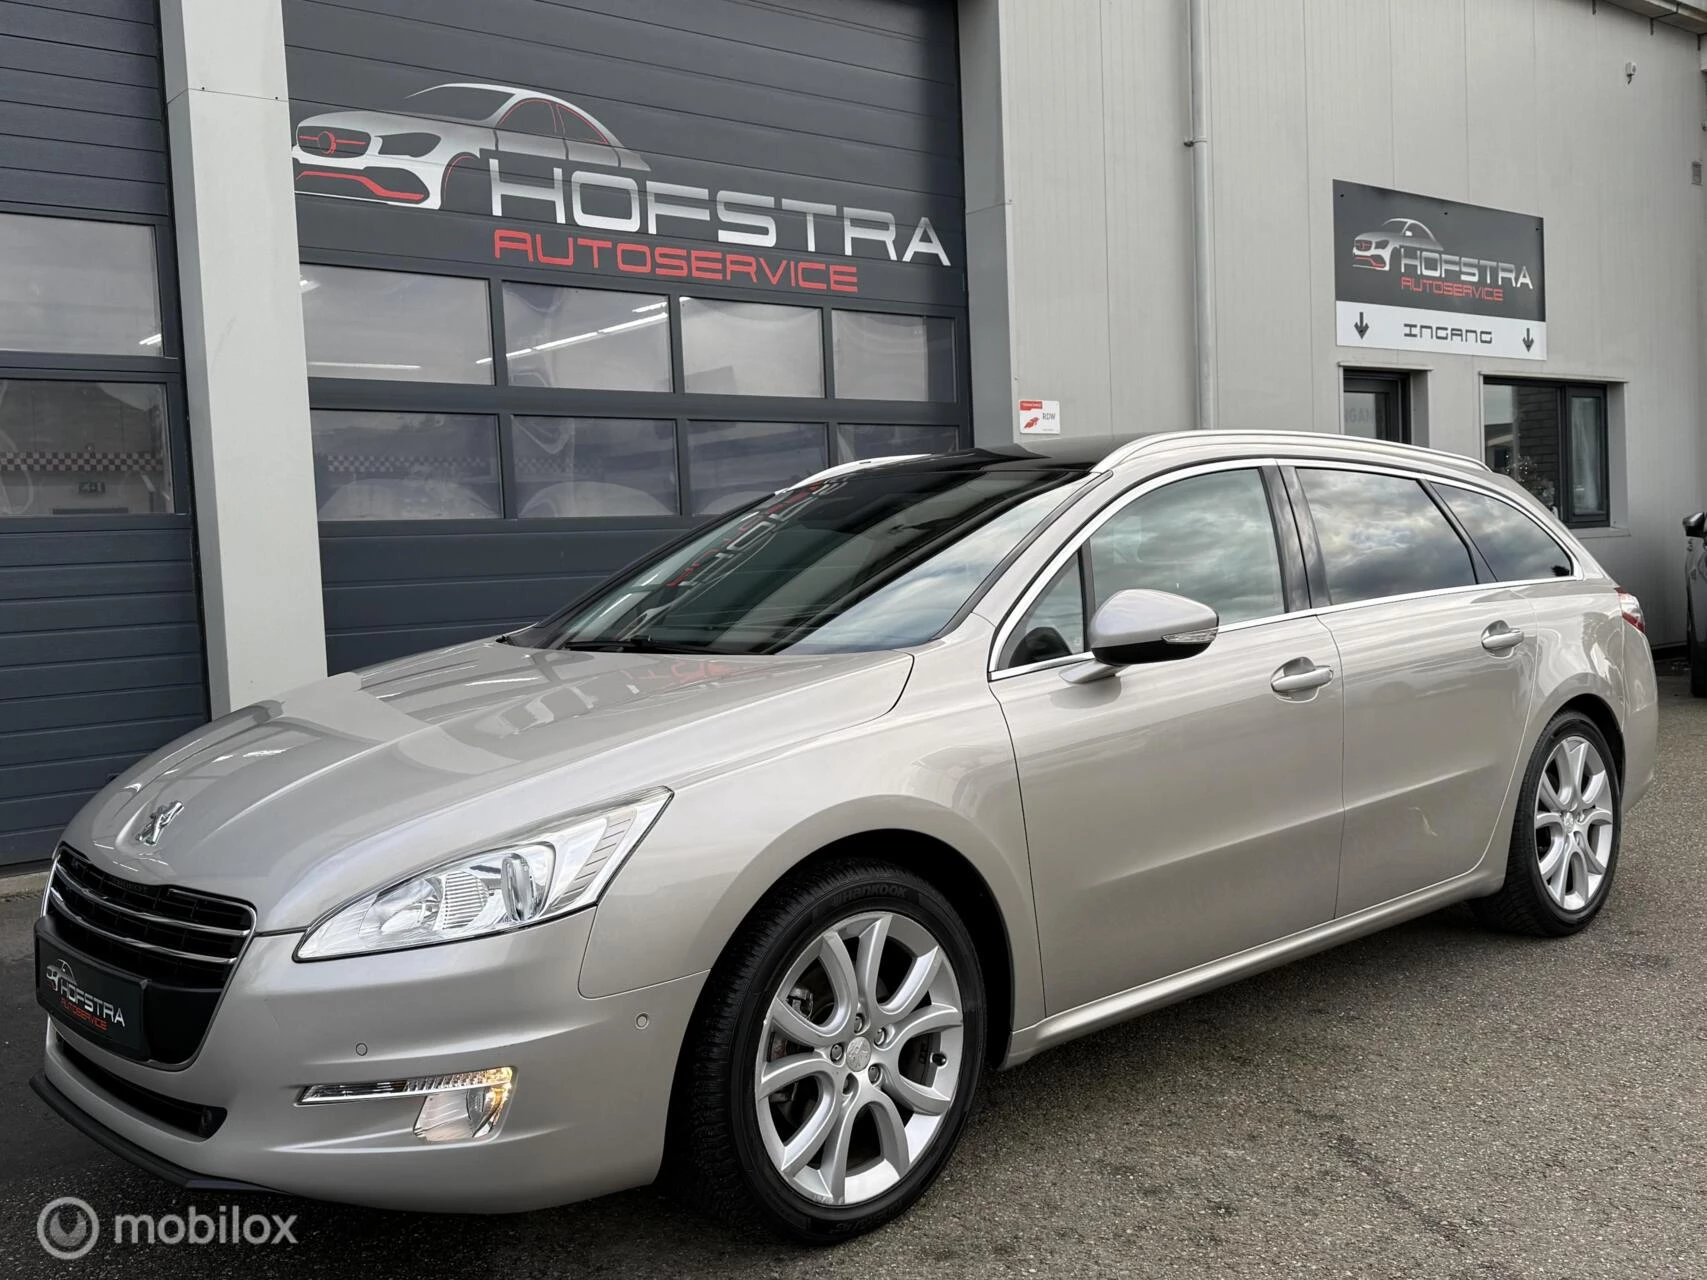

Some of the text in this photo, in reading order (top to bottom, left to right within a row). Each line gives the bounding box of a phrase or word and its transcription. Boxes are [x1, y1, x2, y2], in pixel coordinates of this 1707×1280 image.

[489, 158, 951, 266] HOFSTRA
[493, 229, 858, 293] AUTOSERVICE
[1400, 248, 1534, 289] HOFSTRA
[1400, 277, 1504, 301] AUTOSERVICE
[1403, 323, 1493, 344] INGANG
[1042, 412, 1056, 420] RDW
[60, 979, 126, 1027] HOFSTRA
[60, 997, 108, 1031] AUTOSERVICE
